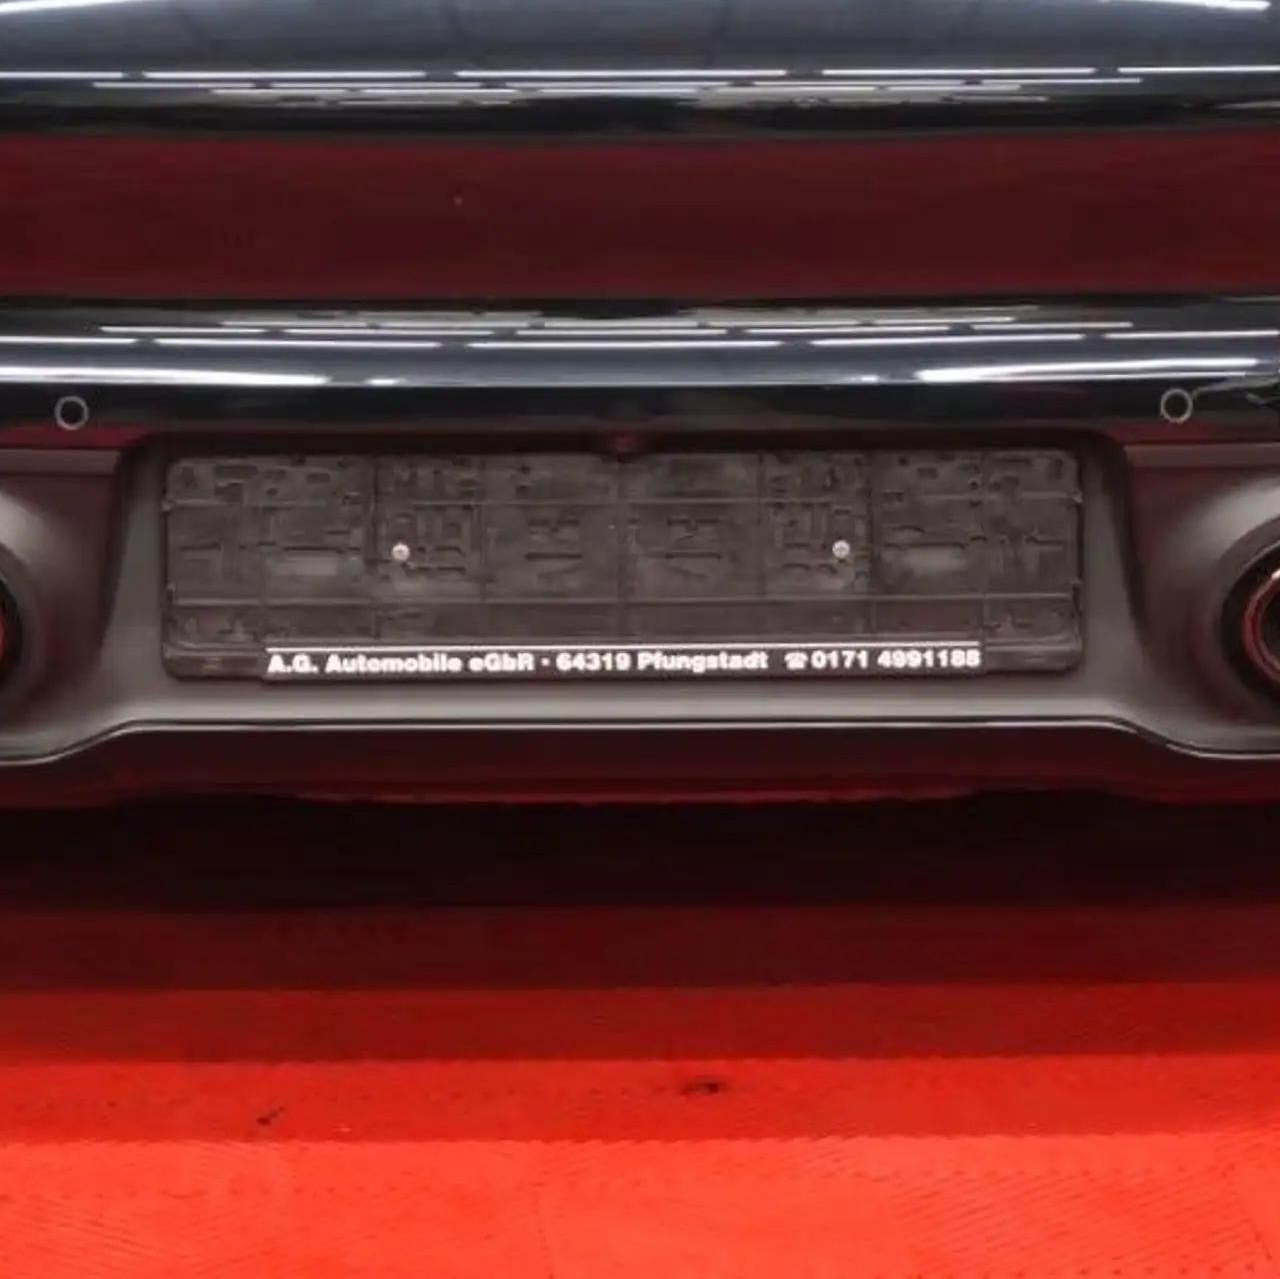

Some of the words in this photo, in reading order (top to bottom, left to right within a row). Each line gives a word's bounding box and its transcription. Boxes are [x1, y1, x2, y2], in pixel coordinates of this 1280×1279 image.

[266, 653, 319, 674] A.G.
[325, 652, 463, 673] Automobile
[468, 652, 535, 672] eGbR
[555, 651, 632, 672] 64319
[637, 650, 769, 674] Pfungstadt
[810, 650, 869, 670] 0171
[876, 649, 981, 669] 4991188
